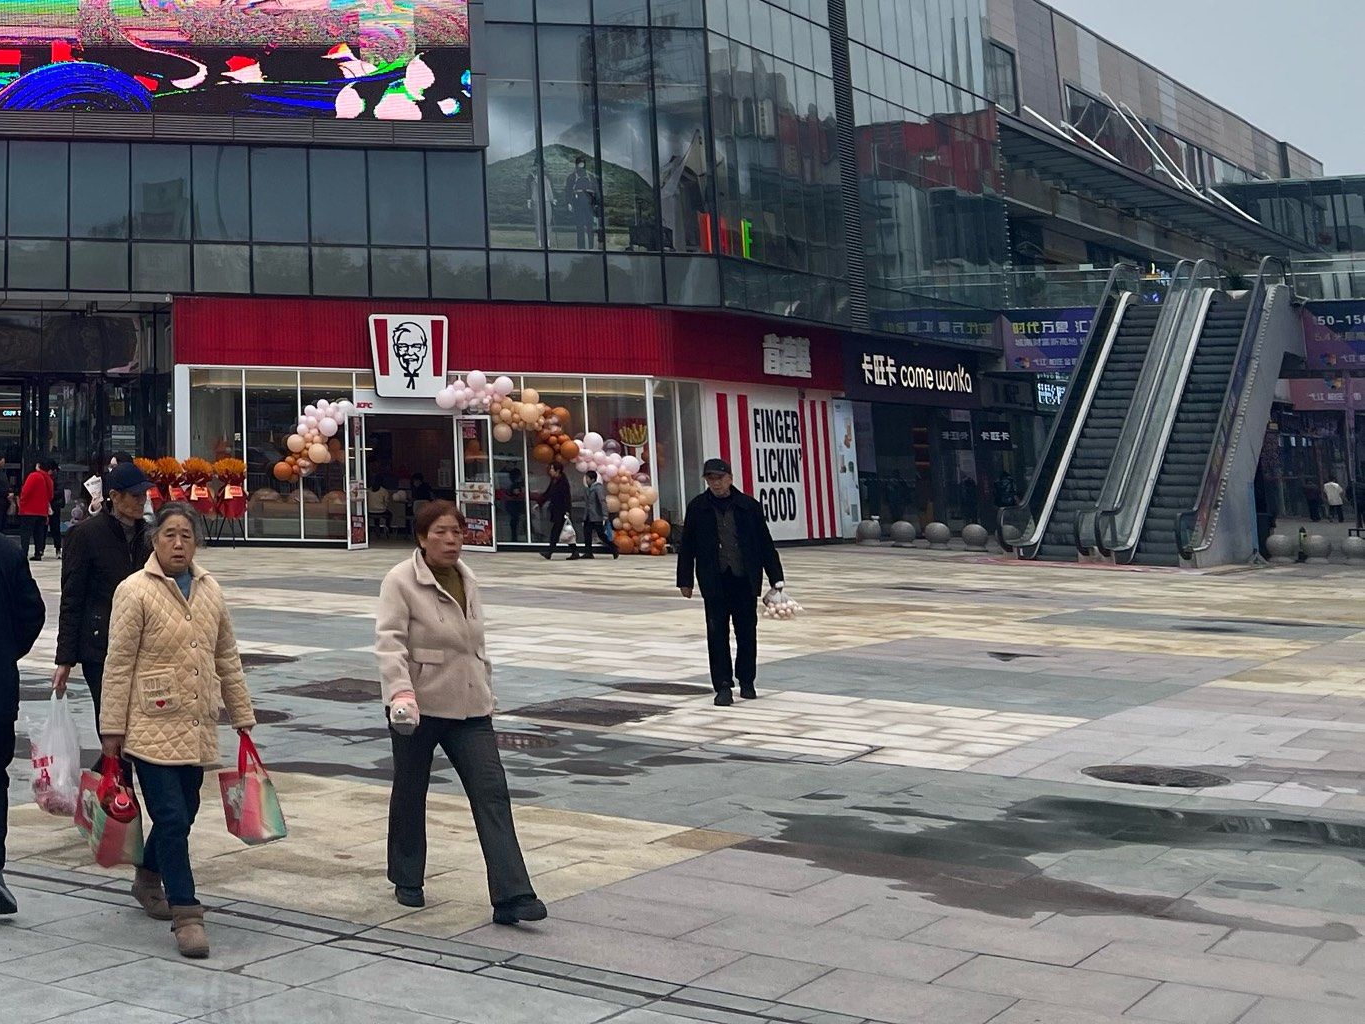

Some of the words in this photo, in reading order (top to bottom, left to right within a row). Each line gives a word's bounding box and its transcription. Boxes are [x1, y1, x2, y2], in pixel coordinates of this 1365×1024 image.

[862, 353, 897, 387] 卡旺卡
[900, 367, 934, 390] come
[753, 408, 800, 444] FINGER
[980, 431, 1010, 441] 卡旺卡
[759, 487, 797, 523] GOOD
